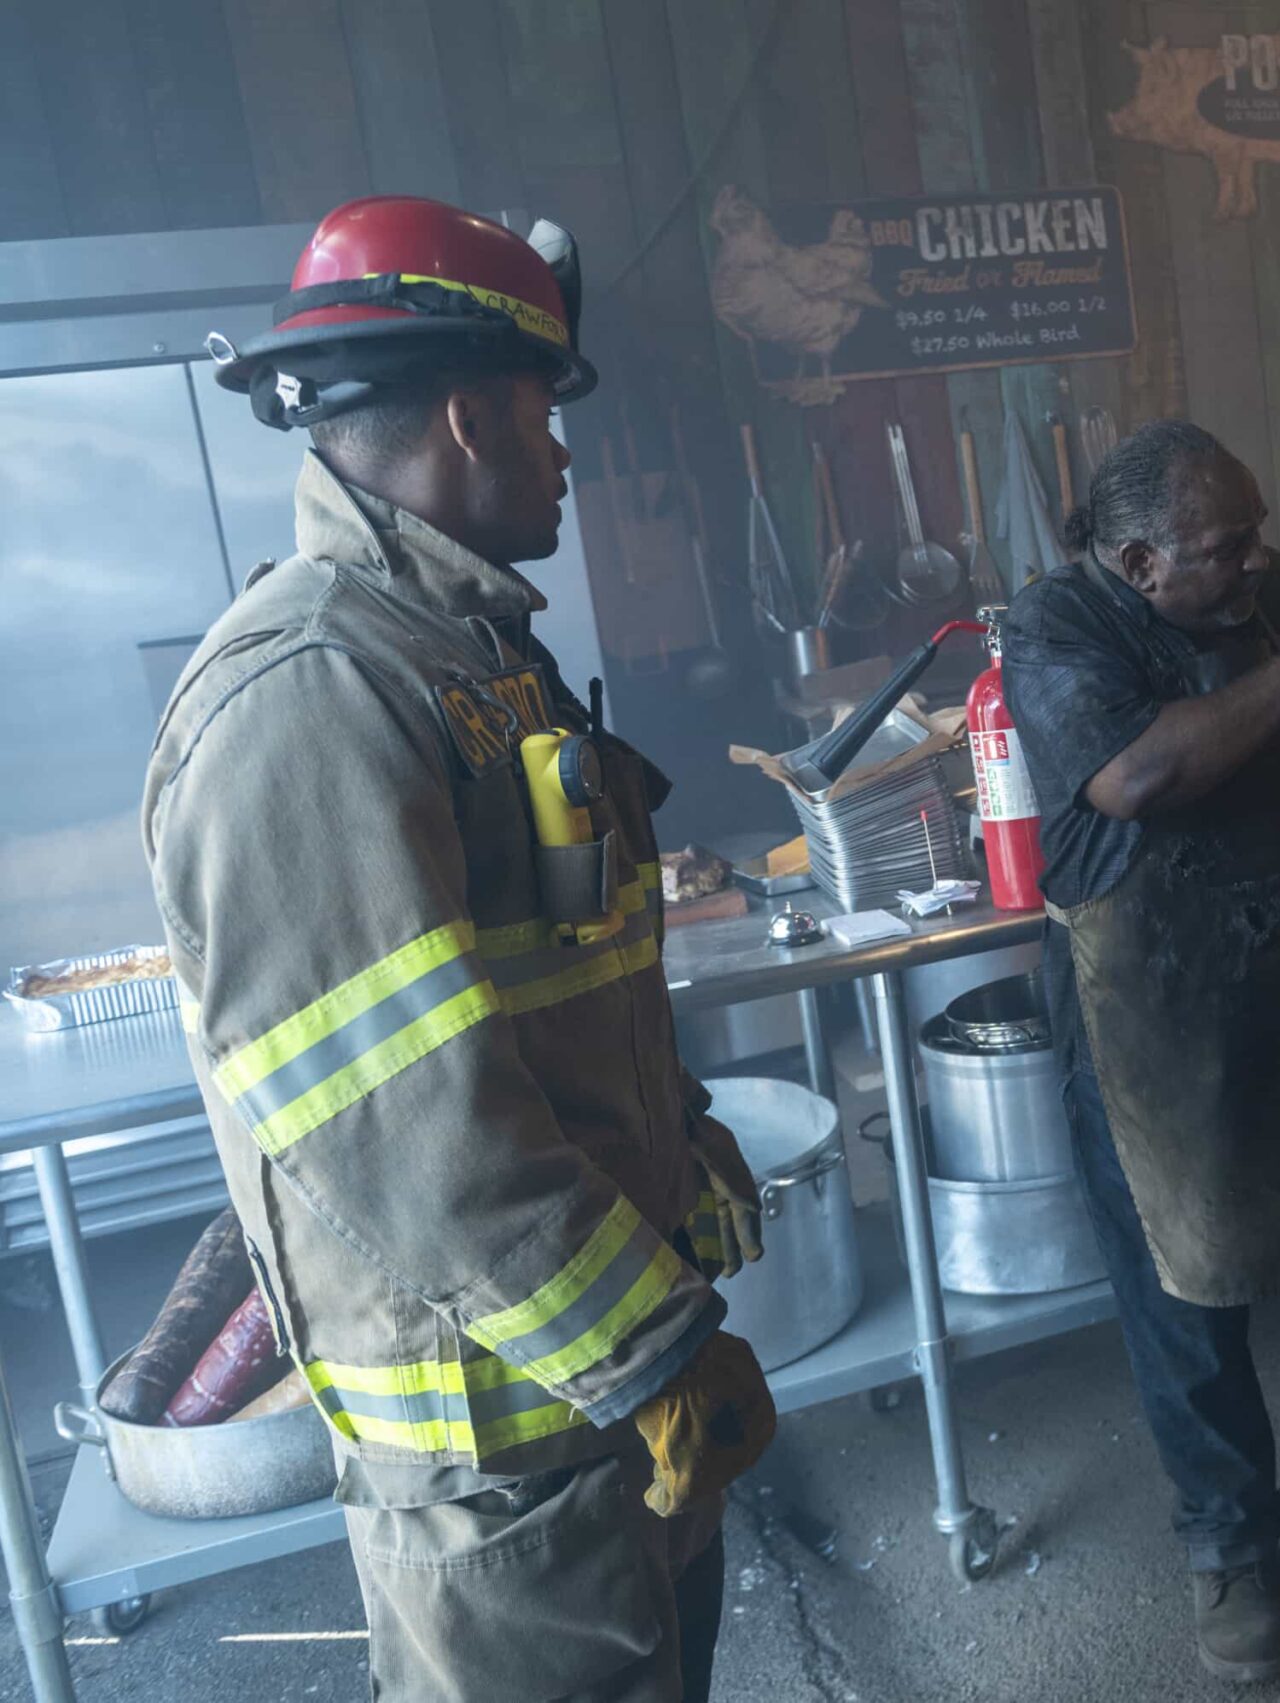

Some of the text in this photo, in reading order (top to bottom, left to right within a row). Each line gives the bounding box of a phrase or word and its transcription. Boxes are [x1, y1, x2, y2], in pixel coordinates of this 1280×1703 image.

[871, 198, 1108, 262] BBQ CHICKEN
[897, 258, 1102, 297] Fried or Flamed
[896, 296, 1107, 330] $9.50 1/4 $16.00 1/2
[909, 324, 1081, 357] $27.50 Whole Bird
